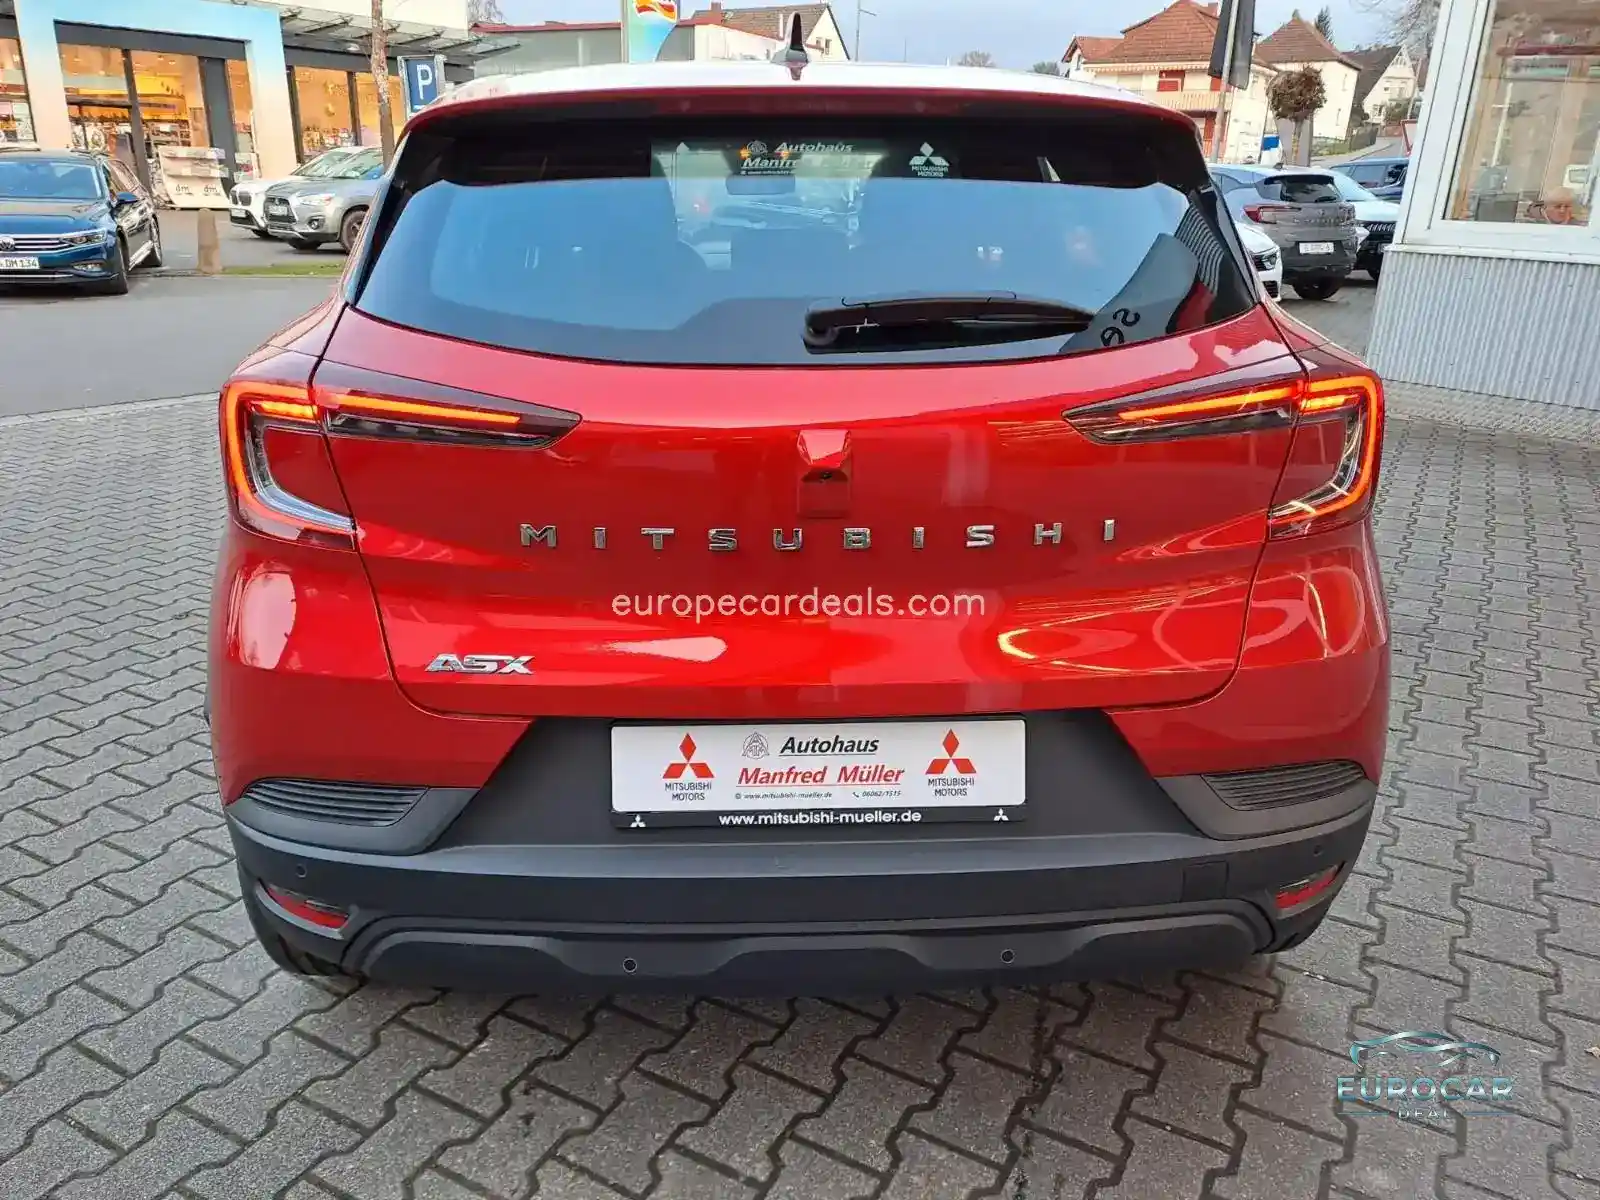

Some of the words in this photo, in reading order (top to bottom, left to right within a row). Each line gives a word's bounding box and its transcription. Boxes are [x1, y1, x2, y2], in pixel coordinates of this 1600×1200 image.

[415, 64, 433, 100] P
[774, 142, 854, 153] Autohaus
[519, 518, 1117, 552] MITSUBISHI
[425, 653, 536, 675] ASX
[779, 735, 880, 755] Autohaus
[737, 765, 829, 785] Manfred
[836, 762, 906, 783] Müller
[928, 777, 975, 787] MITSUBISHI
[664, 782, 712, 791] MITSUBISHI
[934, 788, 968, 797] MOTORS
[671, 792, 706, 802] MOTORS
[719, 809, 923, 826] www.mitsubishi-mueller.de
